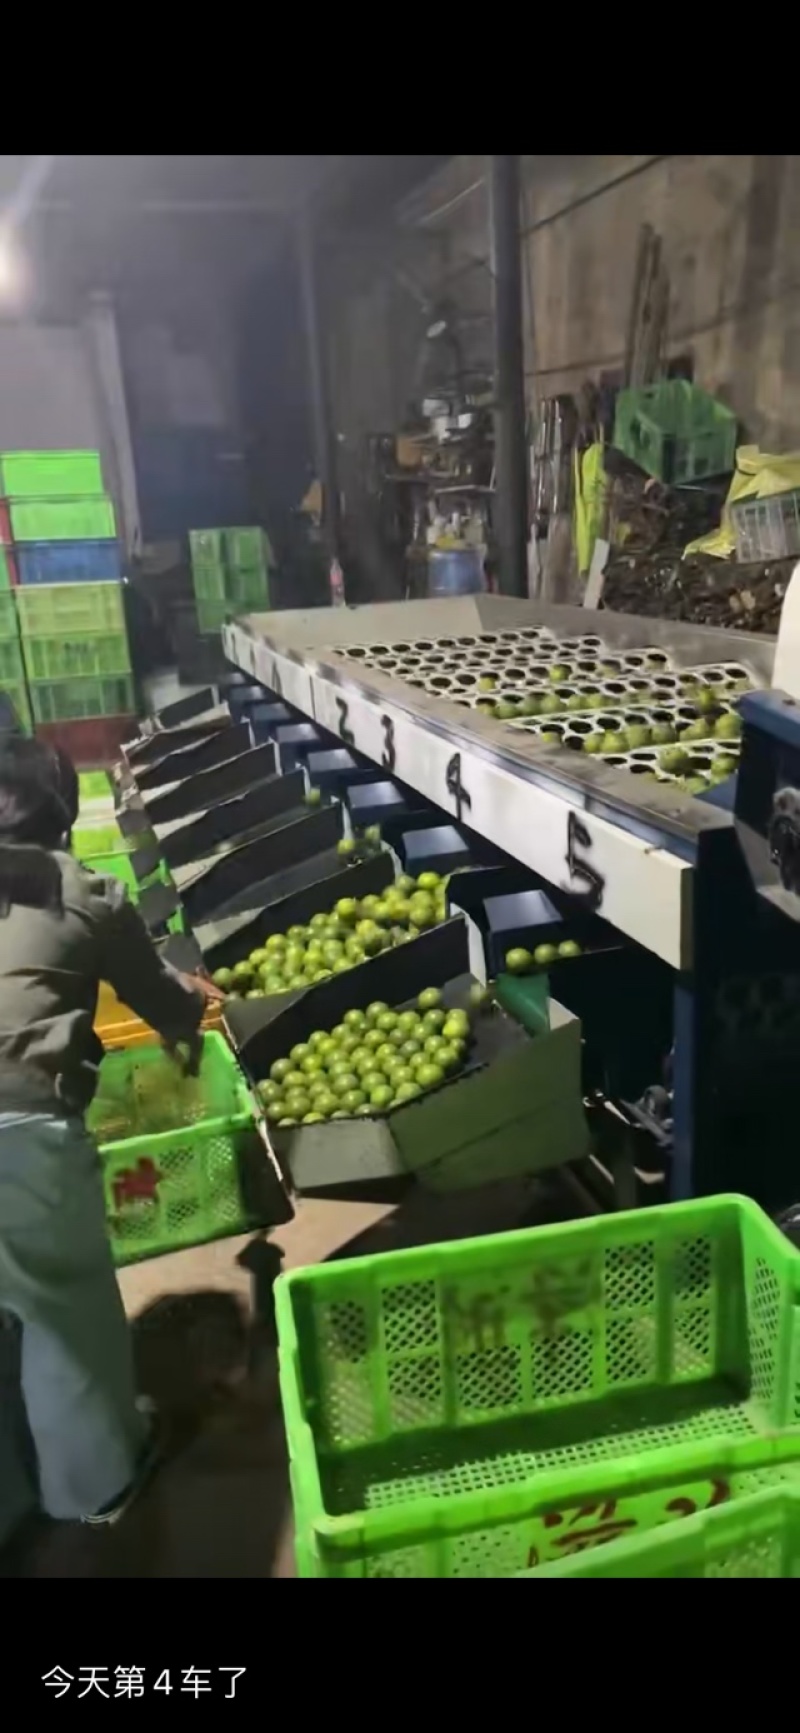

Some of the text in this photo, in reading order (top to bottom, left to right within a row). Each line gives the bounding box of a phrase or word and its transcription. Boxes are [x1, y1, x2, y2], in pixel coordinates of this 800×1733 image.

[335, 696, 355, 749] 2
[380, 714, 396, 774] 3
[445, 752, 472, 821] 4
[564, 810, 605, 911] 5
